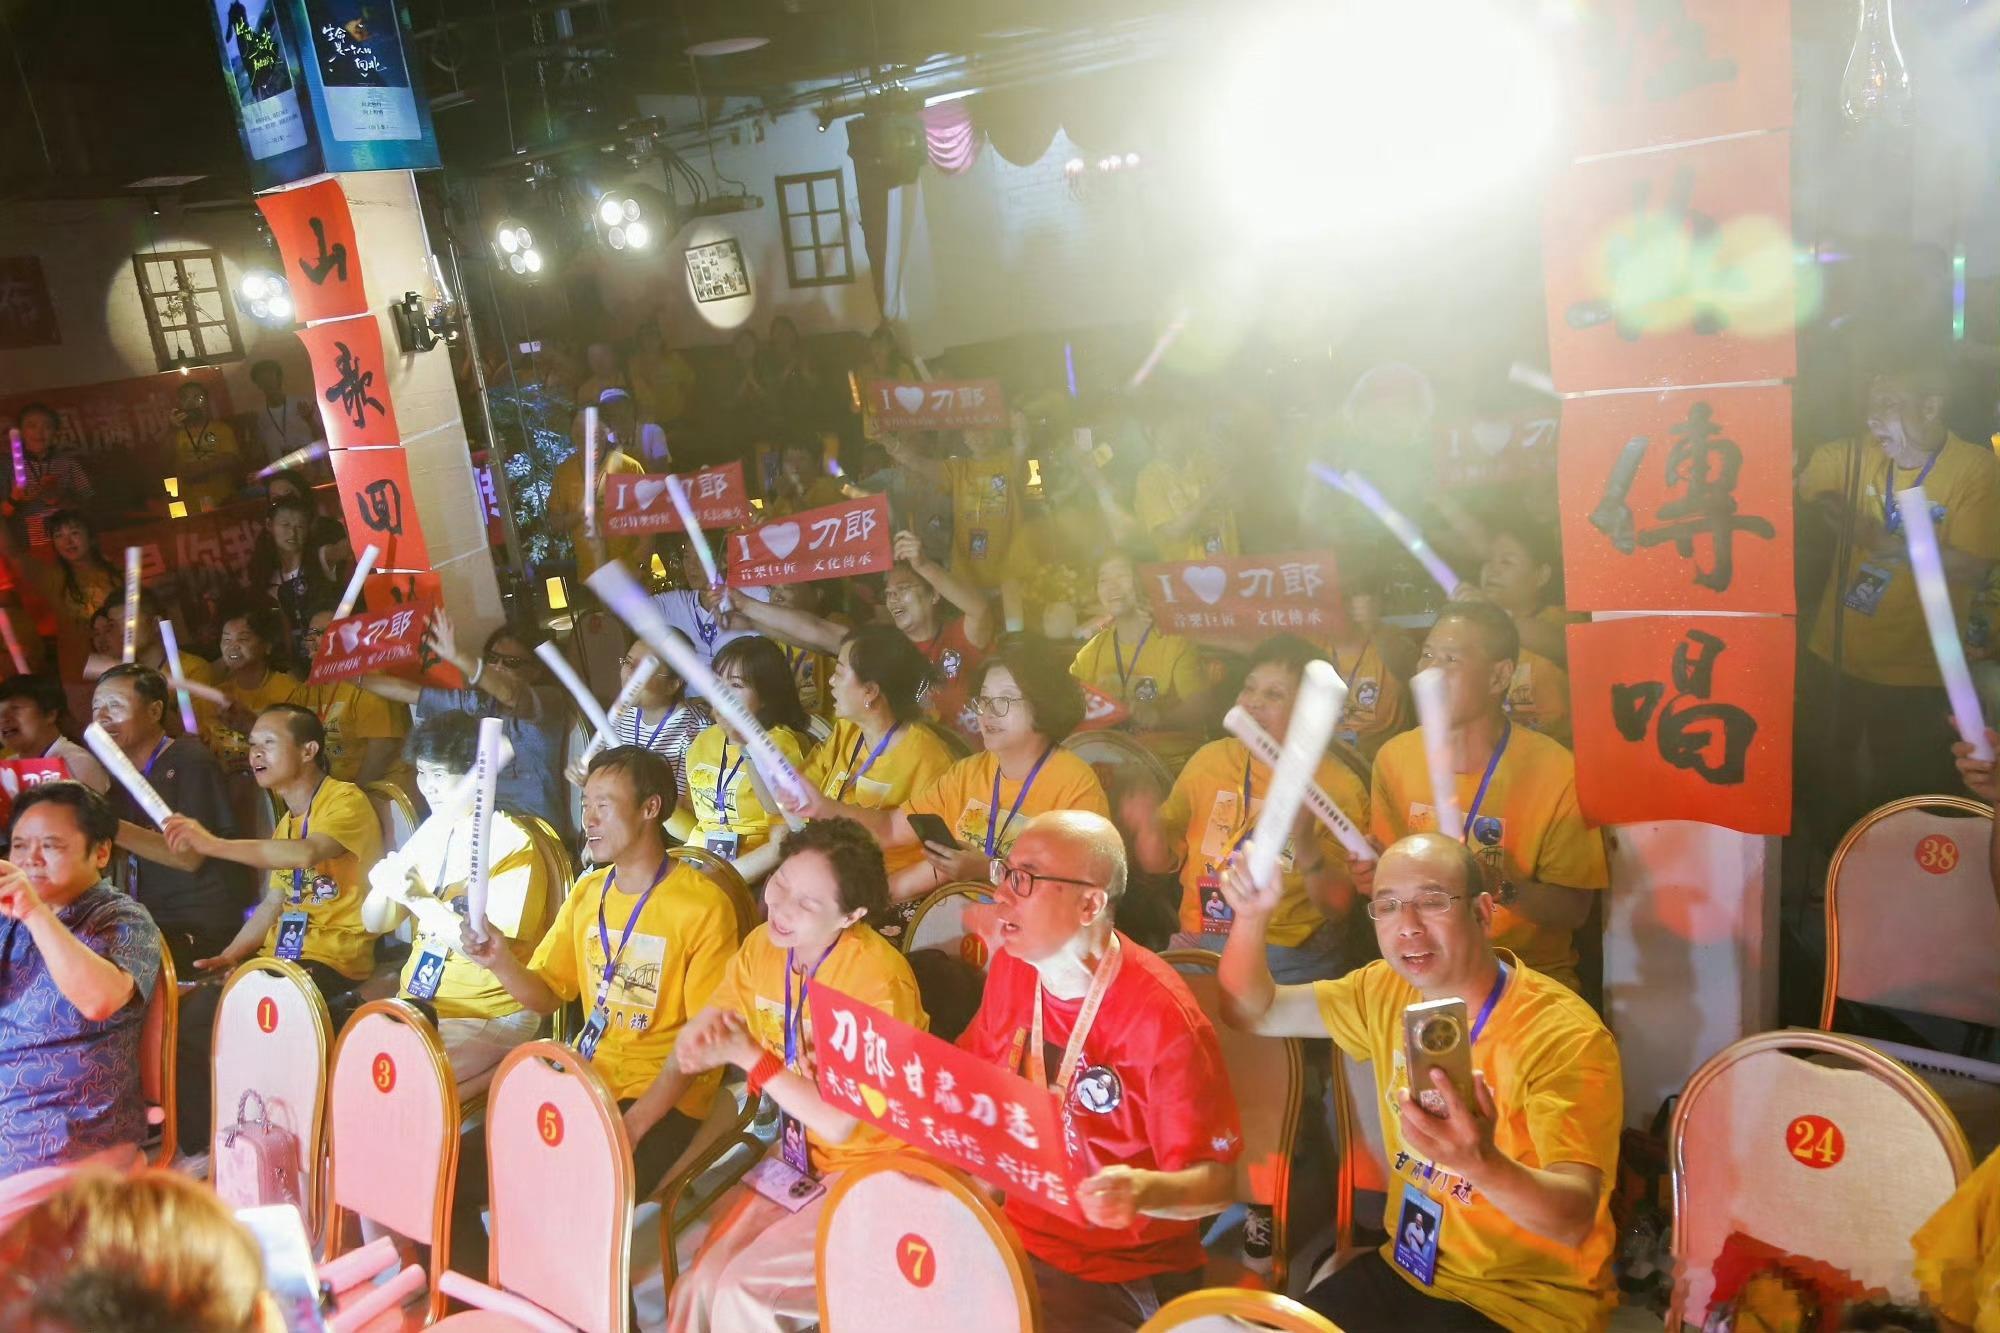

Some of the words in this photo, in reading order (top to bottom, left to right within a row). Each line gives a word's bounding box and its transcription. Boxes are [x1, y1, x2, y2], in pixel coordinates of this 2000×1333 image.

[880, 388, 891, 410] I
[616, 483, 627, 511] I
[735, 534, 751, 563] I
[808, 508, 877, 552] 刀郎
[1155, 575, 1179, 604] I
[1237, 562, 1325, 599] 刀郎
[324, 631, 336, 657] I
[361, 609, 415, 646] 刀郎
[1920, 839, 1958, 870] 38
[262, 1004, 274, 1028] 1
[378, 1059, 391, 1087] 3
[543, 1111, 558, 1141] 5
[1794, 1120, 1836, 1164] 24
[906, 1241, 929, 1281] 7
